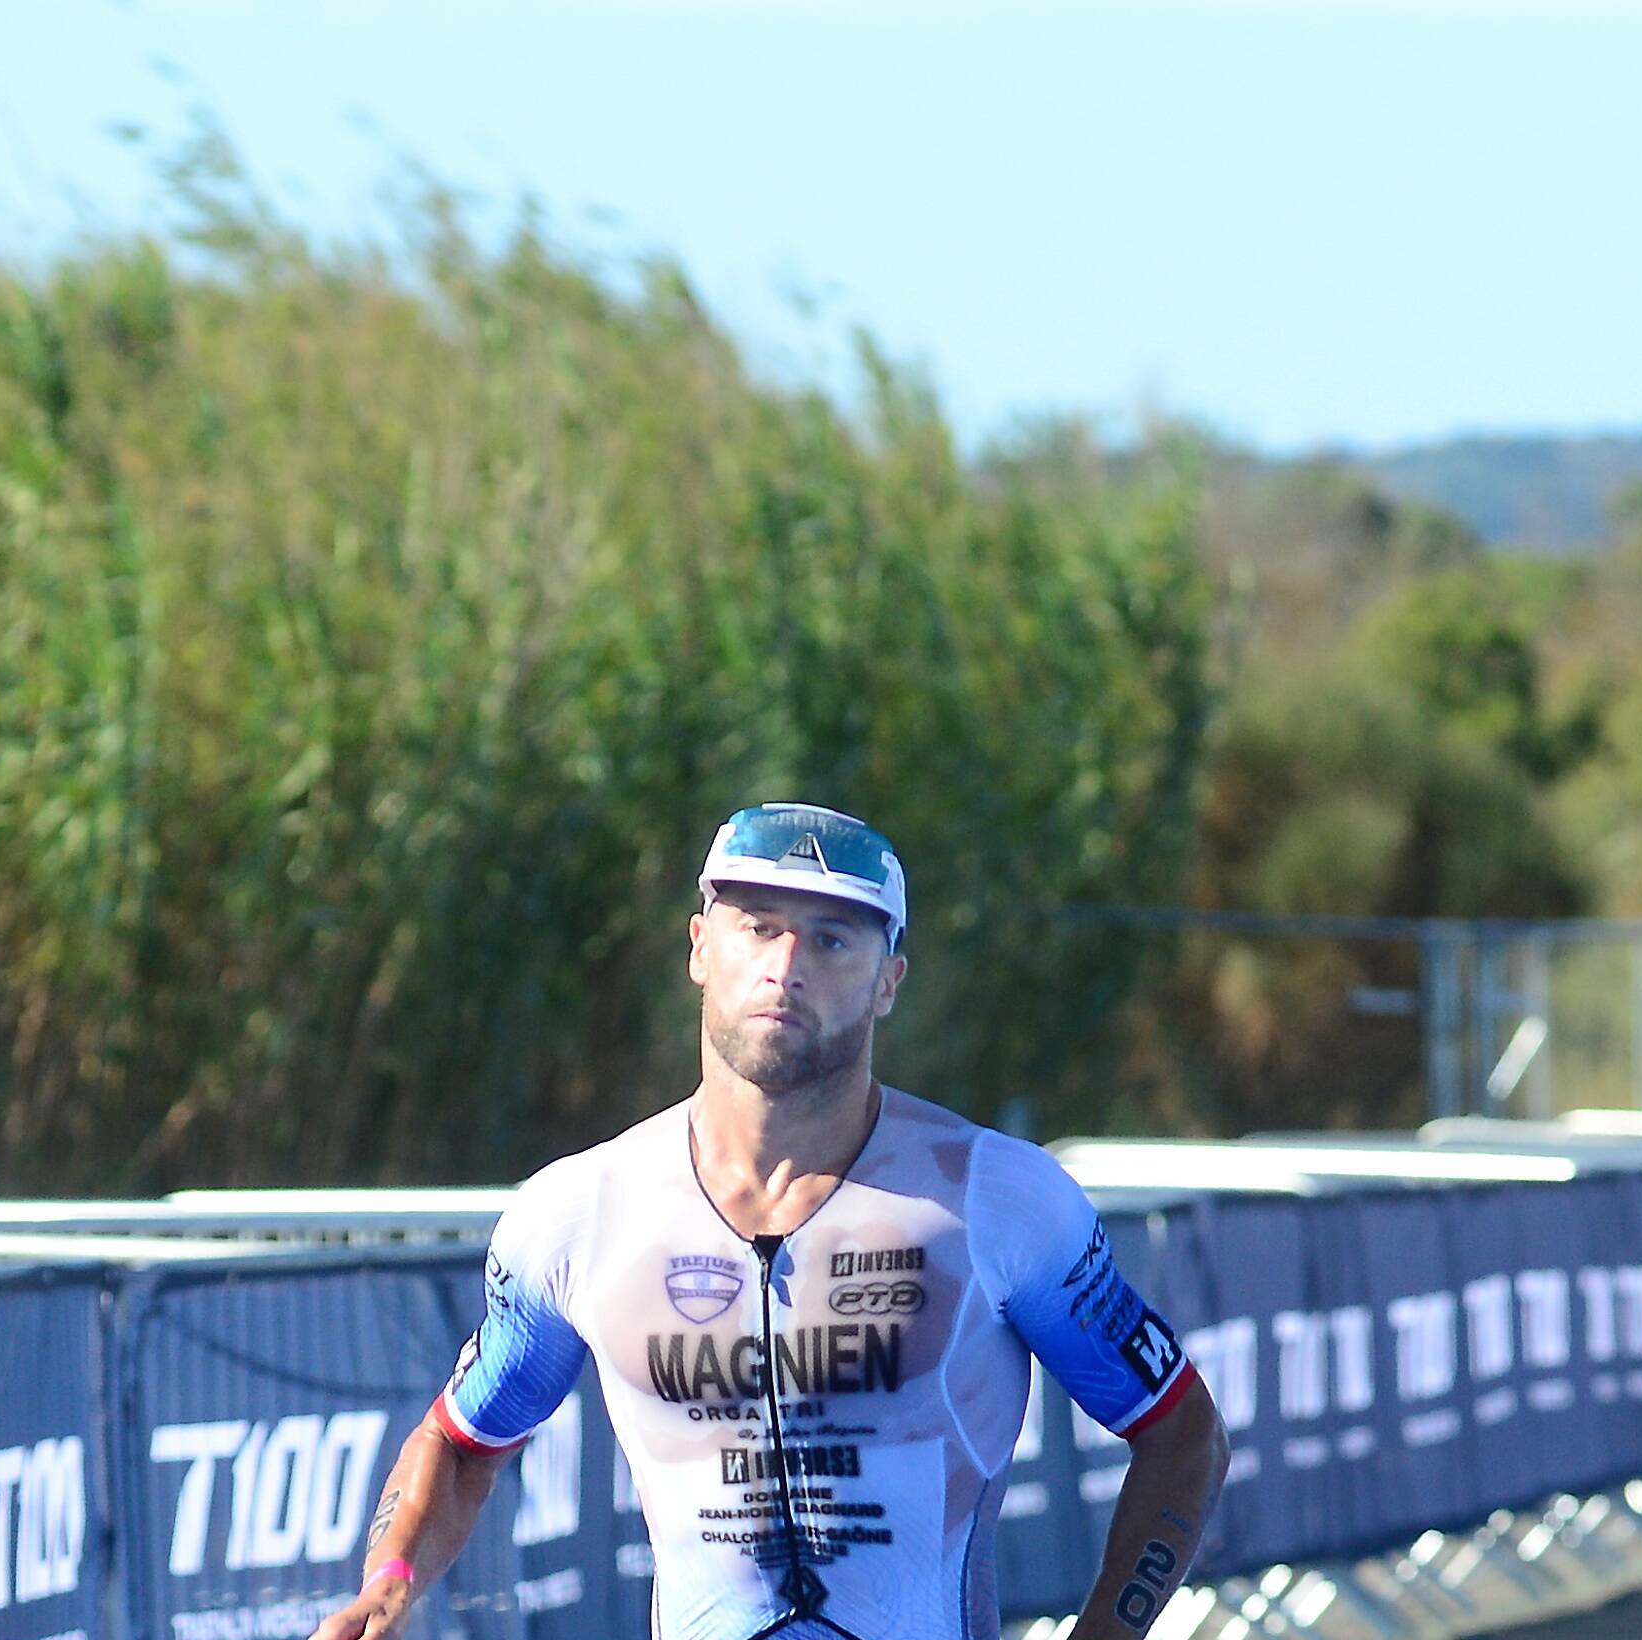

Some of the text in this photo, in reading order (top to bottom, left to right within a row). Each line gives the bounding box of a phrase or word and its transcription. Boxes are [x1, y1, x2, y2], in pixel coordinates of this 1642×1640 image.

[647, 1323, 900, 1403] MAGNIEN
[688, 1406, 761, 1421] ORGA
[150, 1410, 389, 1577] T100
